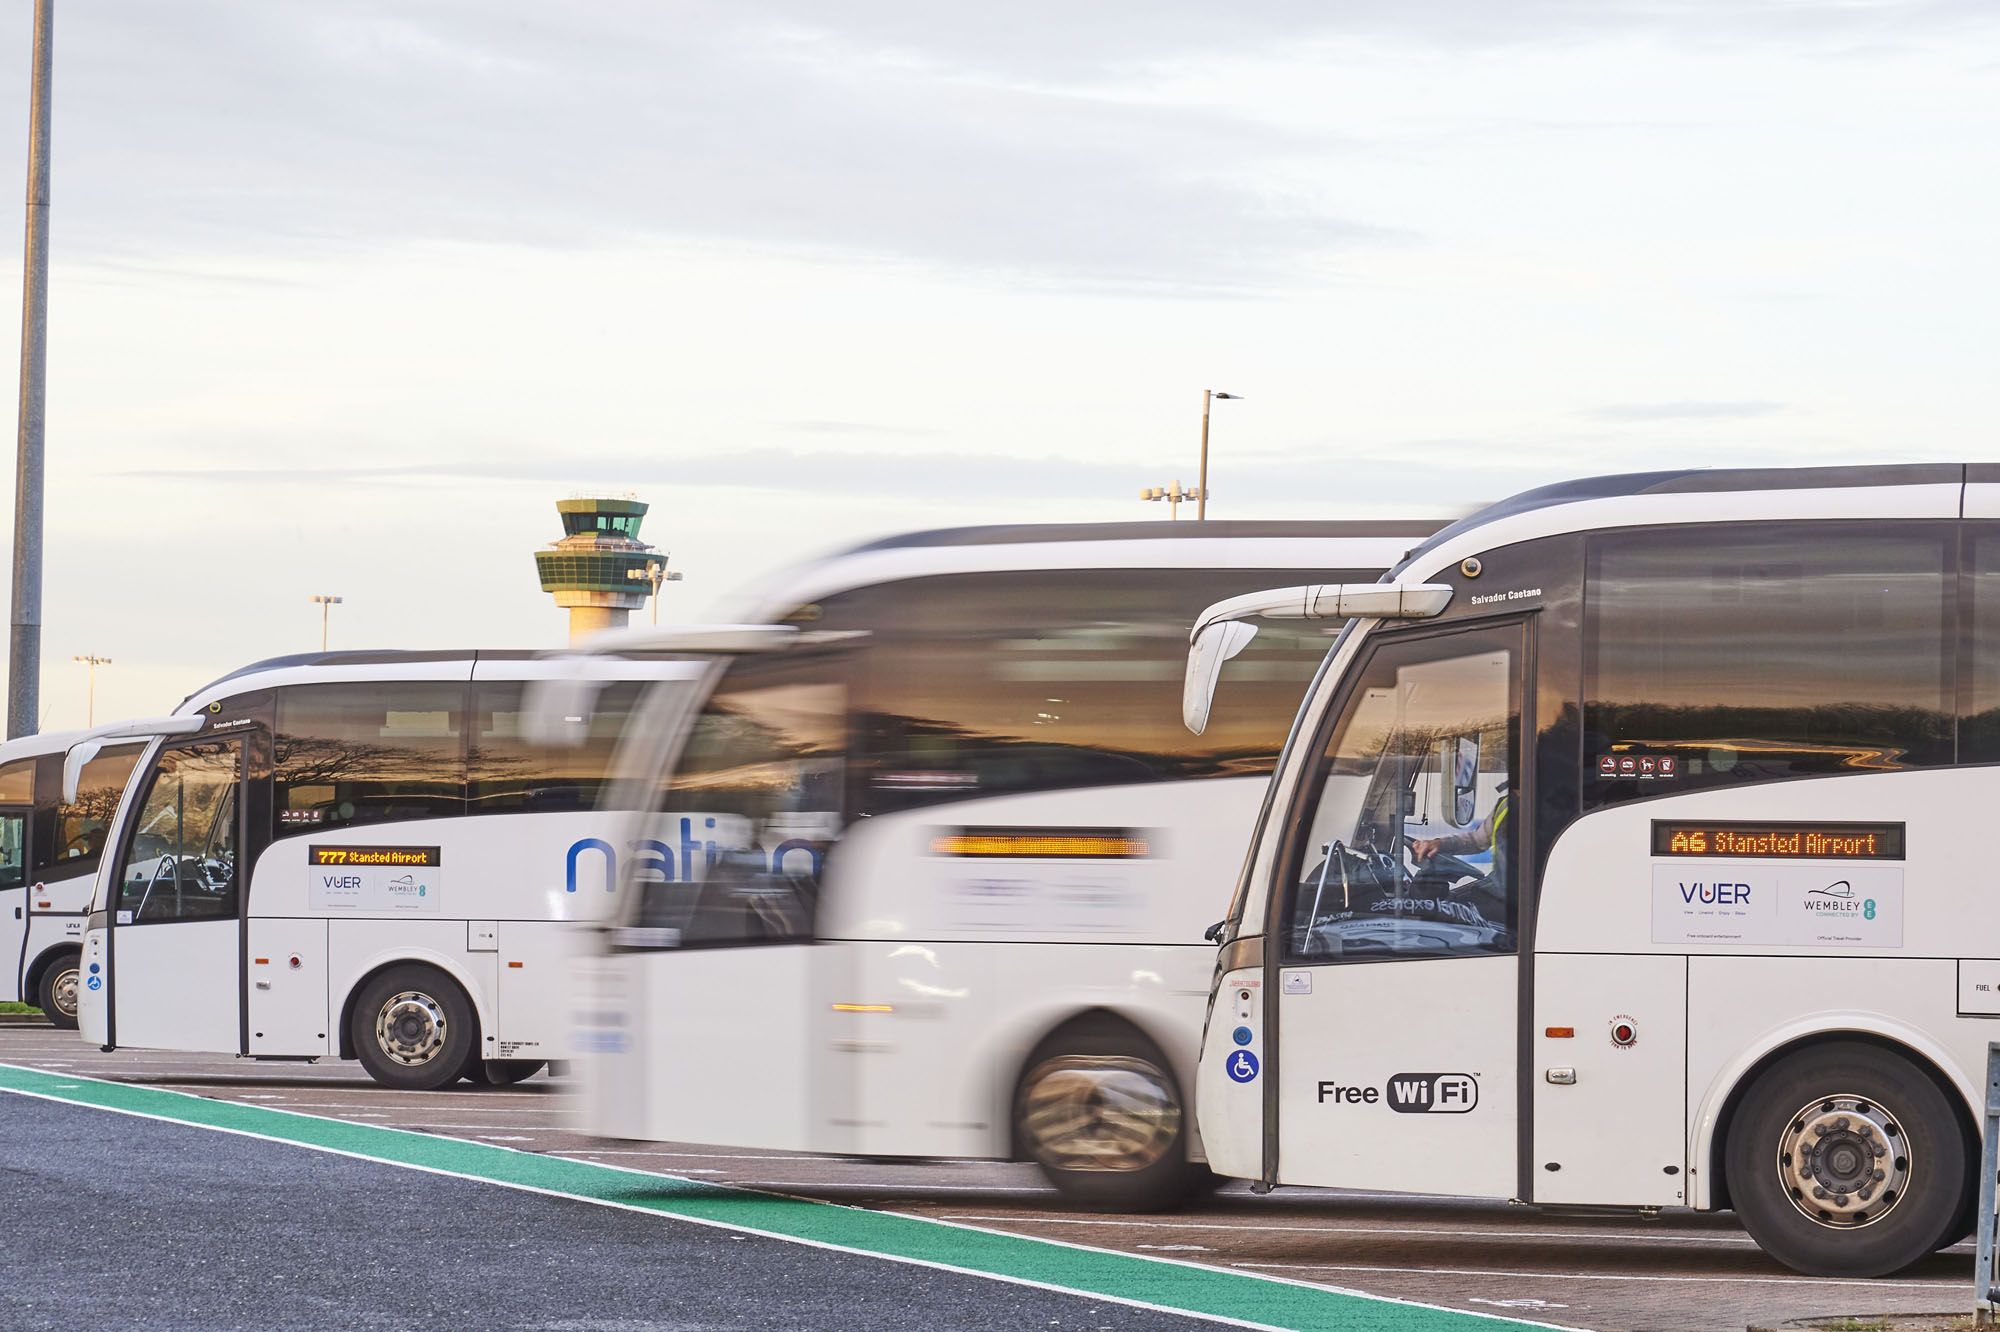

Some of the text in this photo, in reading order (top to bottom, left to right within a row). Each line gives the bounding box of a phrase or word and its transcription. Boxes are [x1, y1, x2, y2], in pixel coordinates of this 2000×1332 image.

[1471, 588, 1542, 605] Salvador Caetano
[1671, 832, 1876, 854] A6 Stansted Airport
[319, 851, 427, 864] 777 Stansted Airport
[323, 876, 361, 889] VUER
[1679, 882, 1751, 904] VUER
[1803, 901, 1860, 911] WEMBLEY
[1976, 984, 1991, 992] FUEL
[1318, 1081, 1379, 1104] Free
